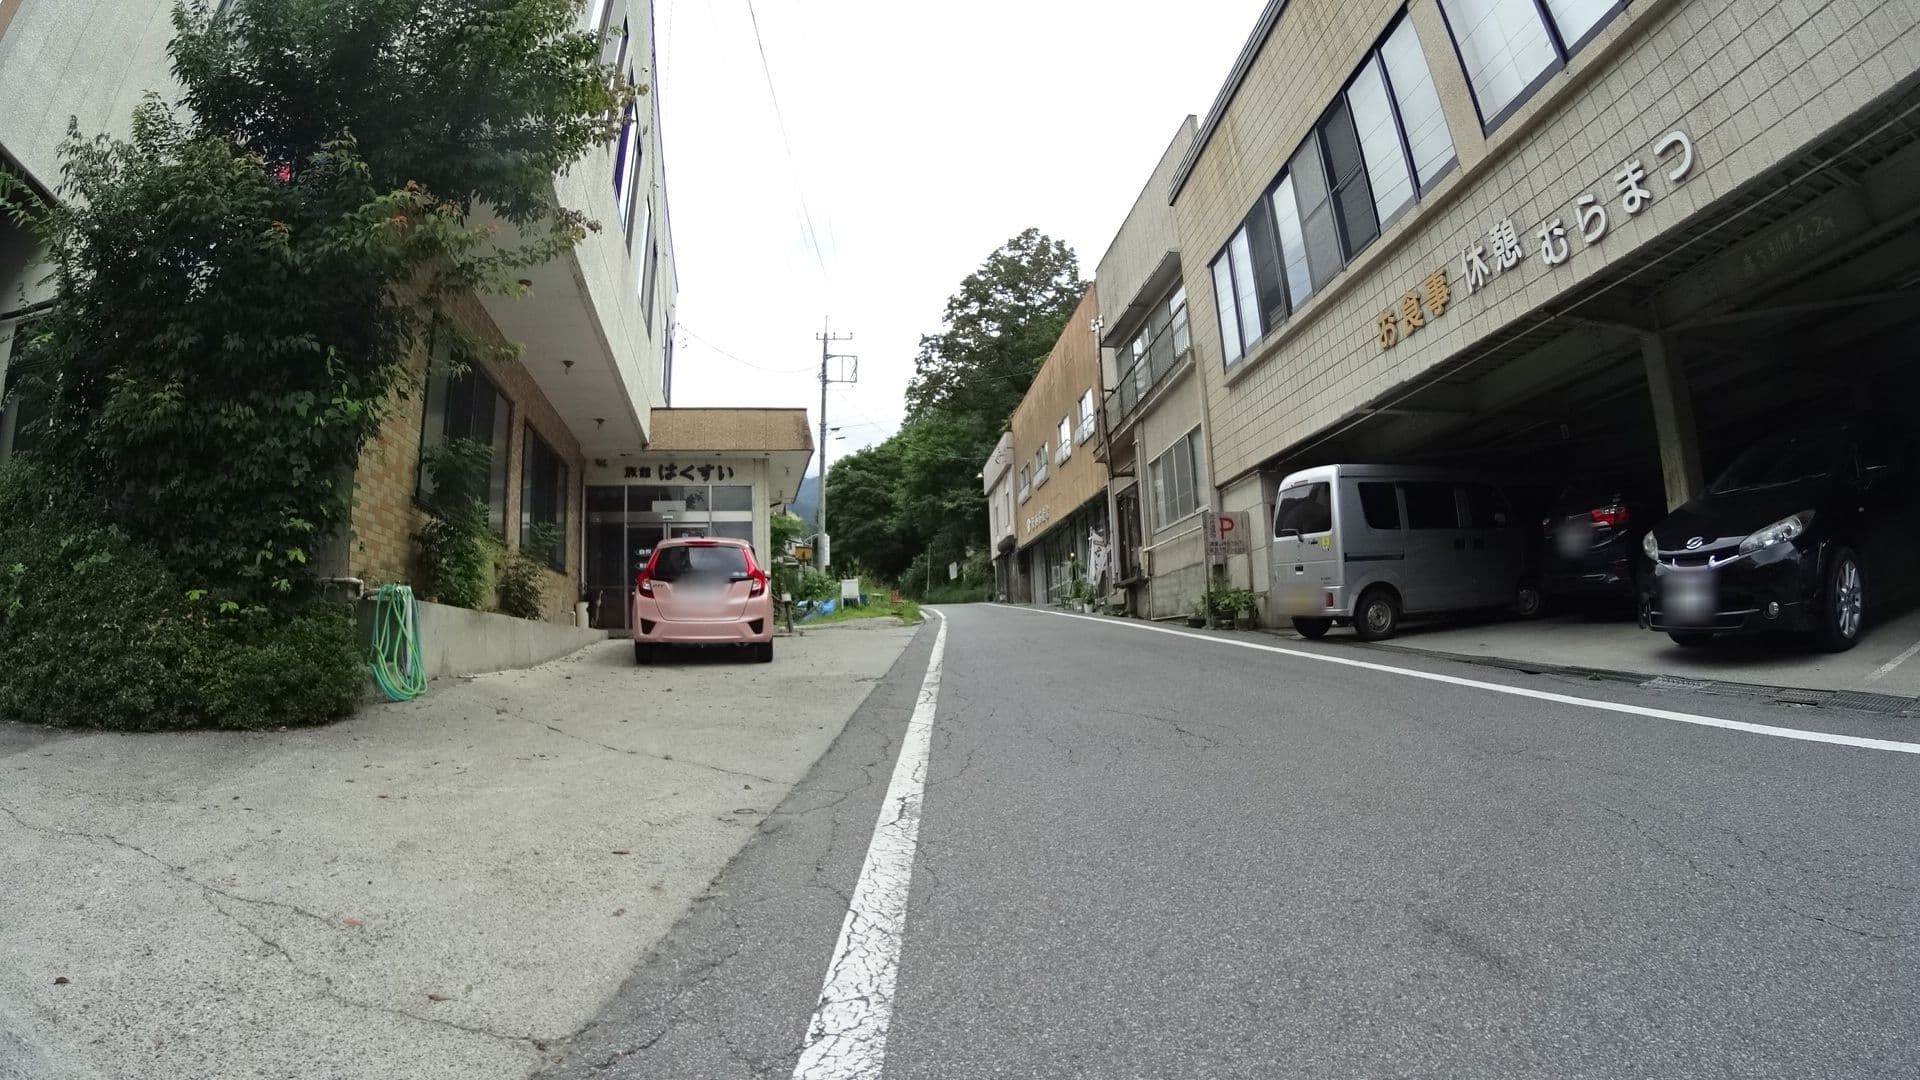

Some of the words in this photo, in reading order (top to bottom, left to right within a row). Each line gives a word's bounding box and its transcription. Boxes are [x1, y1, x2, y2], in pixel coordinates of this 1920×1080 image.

[1377, 269, 1452, 349] お食事
[1461, 217, 1524, 294] 休憩
[1537, 130, 1695, 267] むらまつ
[624, 466, 652, 479] 旅館
[658, 463, 735, 481] はくすい
[1219, 517, 1235, 540] P
